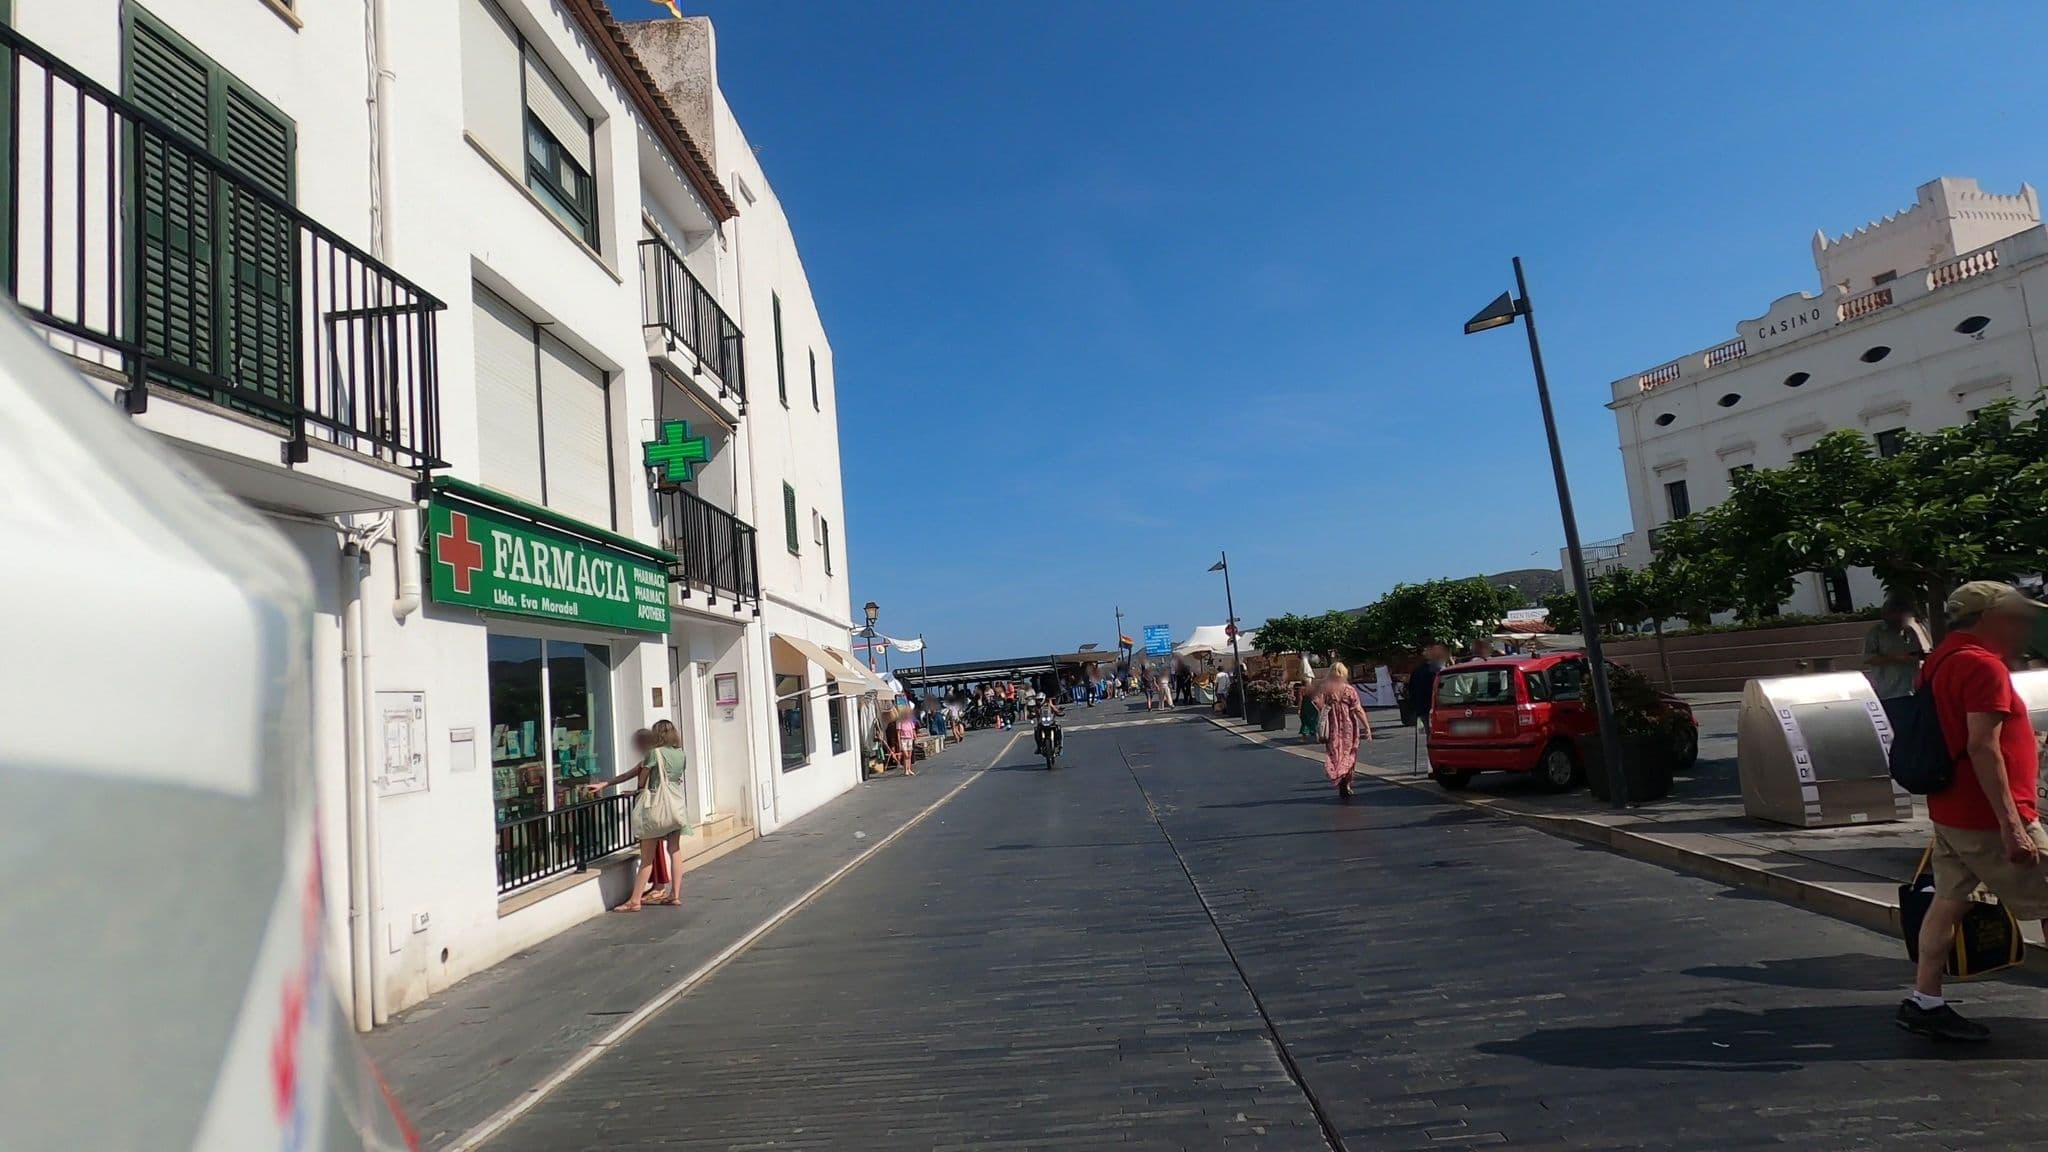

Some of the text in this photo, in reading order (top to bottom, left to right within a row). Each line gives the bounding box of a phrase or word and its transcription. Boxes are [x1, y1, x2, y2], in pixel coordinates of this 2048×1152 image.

[1759, 308, 1820, 339] CASINO
[491, 529, 630, 603] FARMÀCIA
[520, 593, 538, 610] Eva
[634, 585, 666, 605] PHARMACY
[637, 603, 666, 622] APOTHEKE
